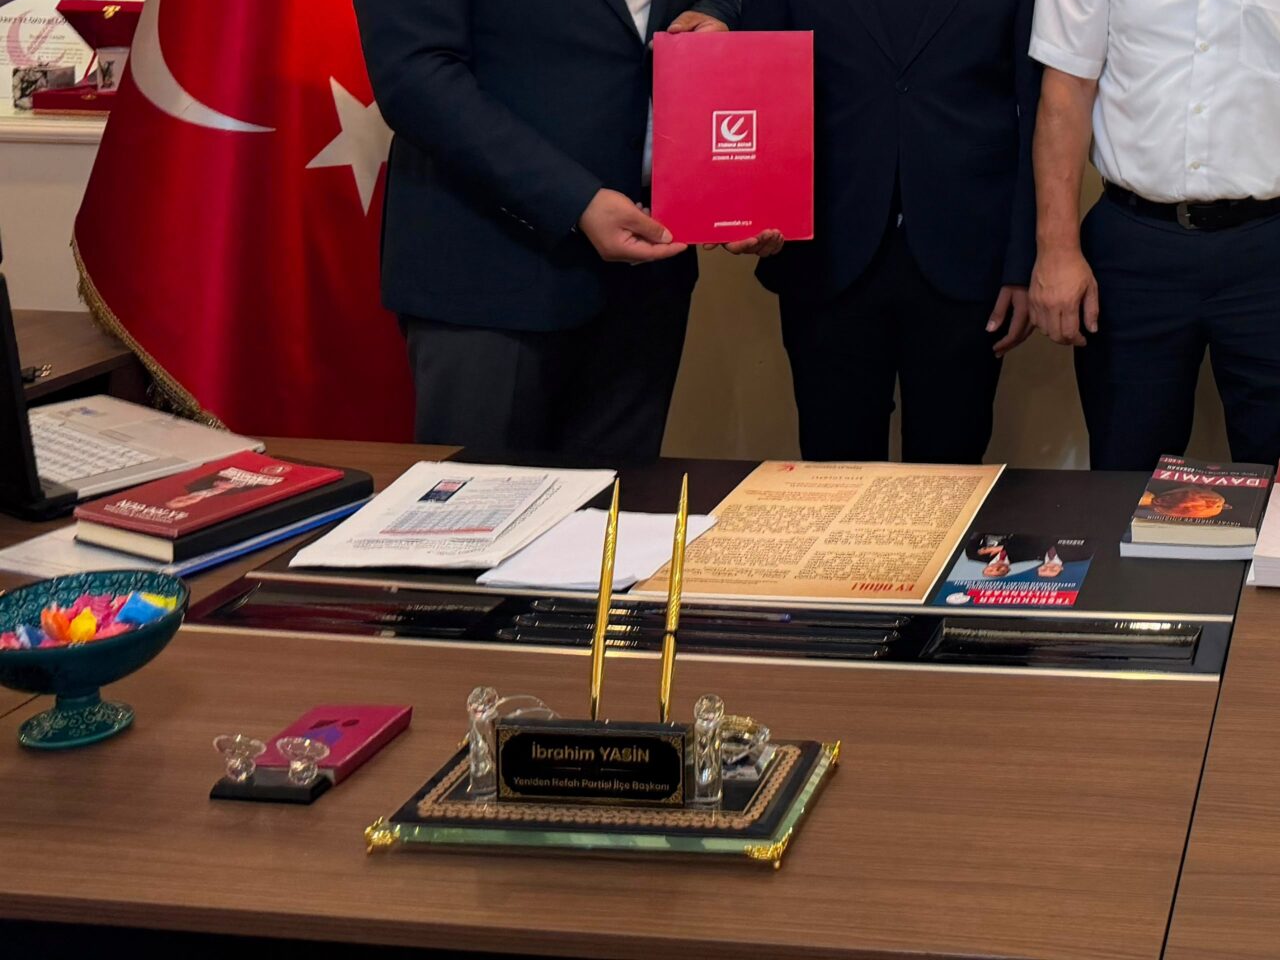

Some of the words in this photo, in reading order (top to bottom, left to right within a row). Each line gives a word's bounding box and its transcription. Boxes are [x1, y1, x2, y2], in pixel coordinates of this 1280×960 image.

[1160, 470, 1260, 486] DAVAMIZ
[532, 741, 595, 761] İbrahim
[600, 744, 650, 763] YASİN
[513, 776, 550, 786] Yeniden
[552, 777, 580, 788] Refah
[581, 778, 612, 790] Partisi
[632, 780, 670, 792] Başkanı
